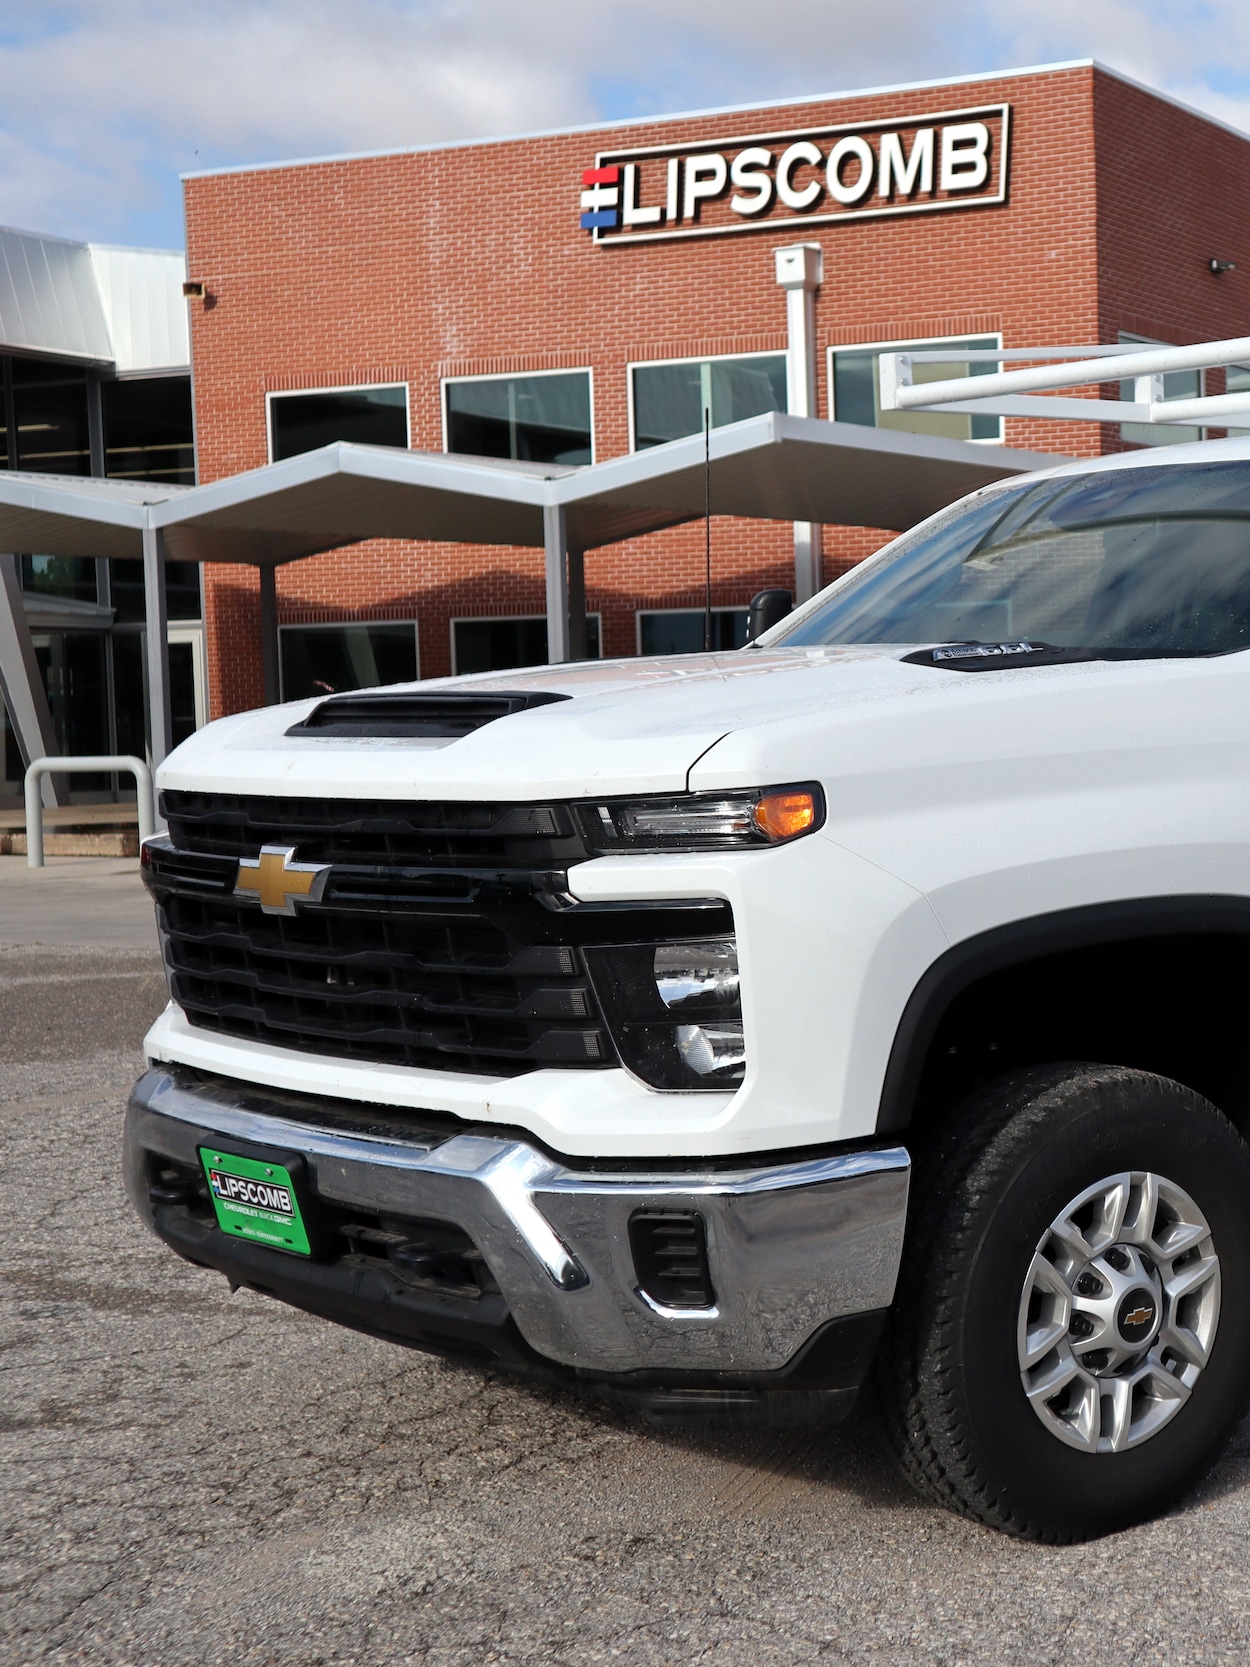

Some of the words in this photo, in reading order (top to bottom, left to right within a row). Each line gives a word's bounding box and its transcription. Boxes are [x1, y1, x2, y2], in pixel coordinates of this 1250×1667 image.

[622, 121, 990, 226] LIPSCOMB
[216, 1174, 291, 1212] LIPSCOMB
[223, 1202, 258, 1217] CHEVROLET
[274, 1215, 292, 1226] GMC
